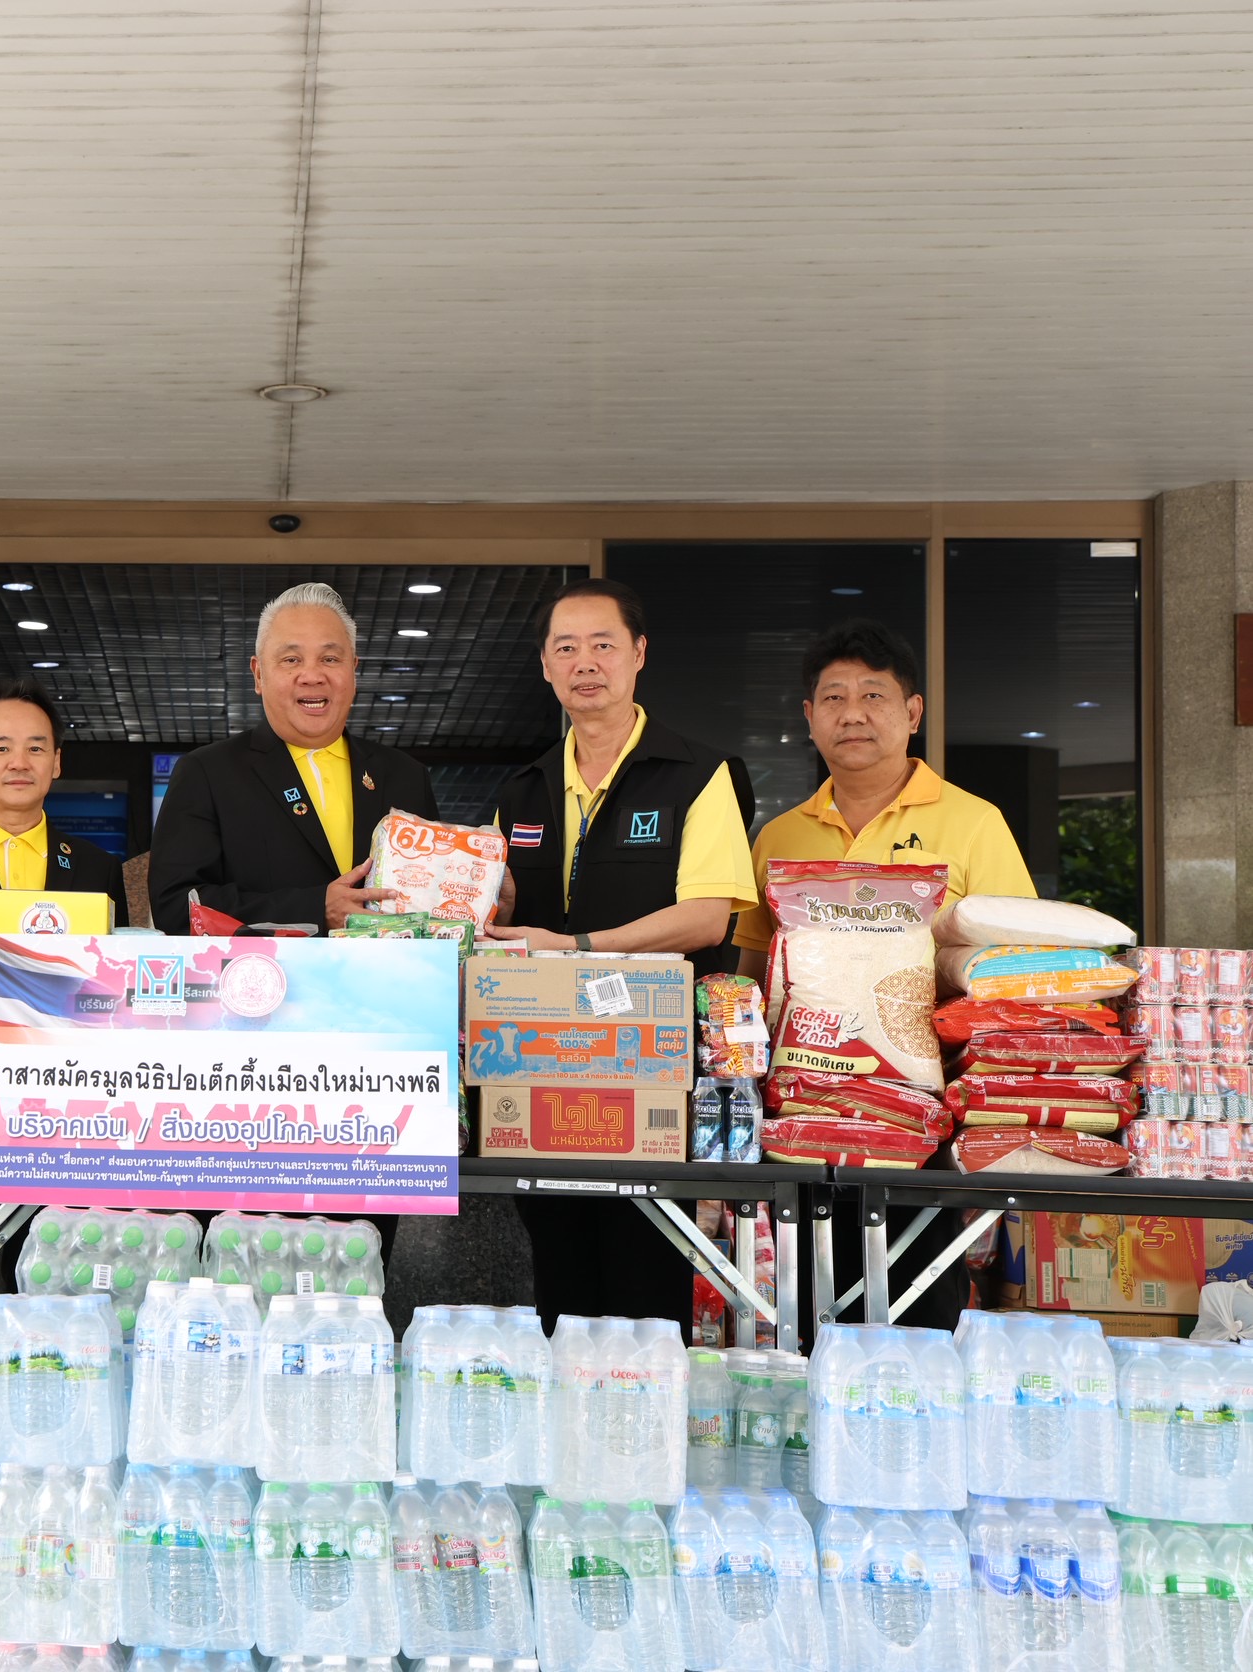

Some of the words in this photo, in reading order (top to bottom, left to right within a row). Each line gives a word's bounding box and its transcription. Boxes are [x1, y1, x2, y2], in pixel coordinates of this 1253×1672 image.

[396, 827, 431, 851] 79
[455, 882, 469, 892] Day
[442, 890, 475, 902] HAPPY
[665, 969, 672, 978] 8
[79, 999, 115, 1012] บุรีรัมย์
[792, 1006, 840, 1030] สุดคุ้ม
[559, 1028, 608, 1040] นมโคสดแท้
[559, 1039, 590, 1049] 100%
[560, 1053, 586, 1063] รสจืด
[787, 1051, 855, 1072] ขนาดพิเศษ
[8, 1113, 126, 1137] บริจาคเงิน
[162, 1111, 396, 1147] สิ่งของอุปโภค-บริโภค
[38, 1152, 56, 1165] เป็น
[351, 1157, 447, 1173] ที่ได้รับผลกระทบจาก
[1022, 1374, 1053, 1390] LIFE
[1077, 1378, 1108, 1393] LIFE
